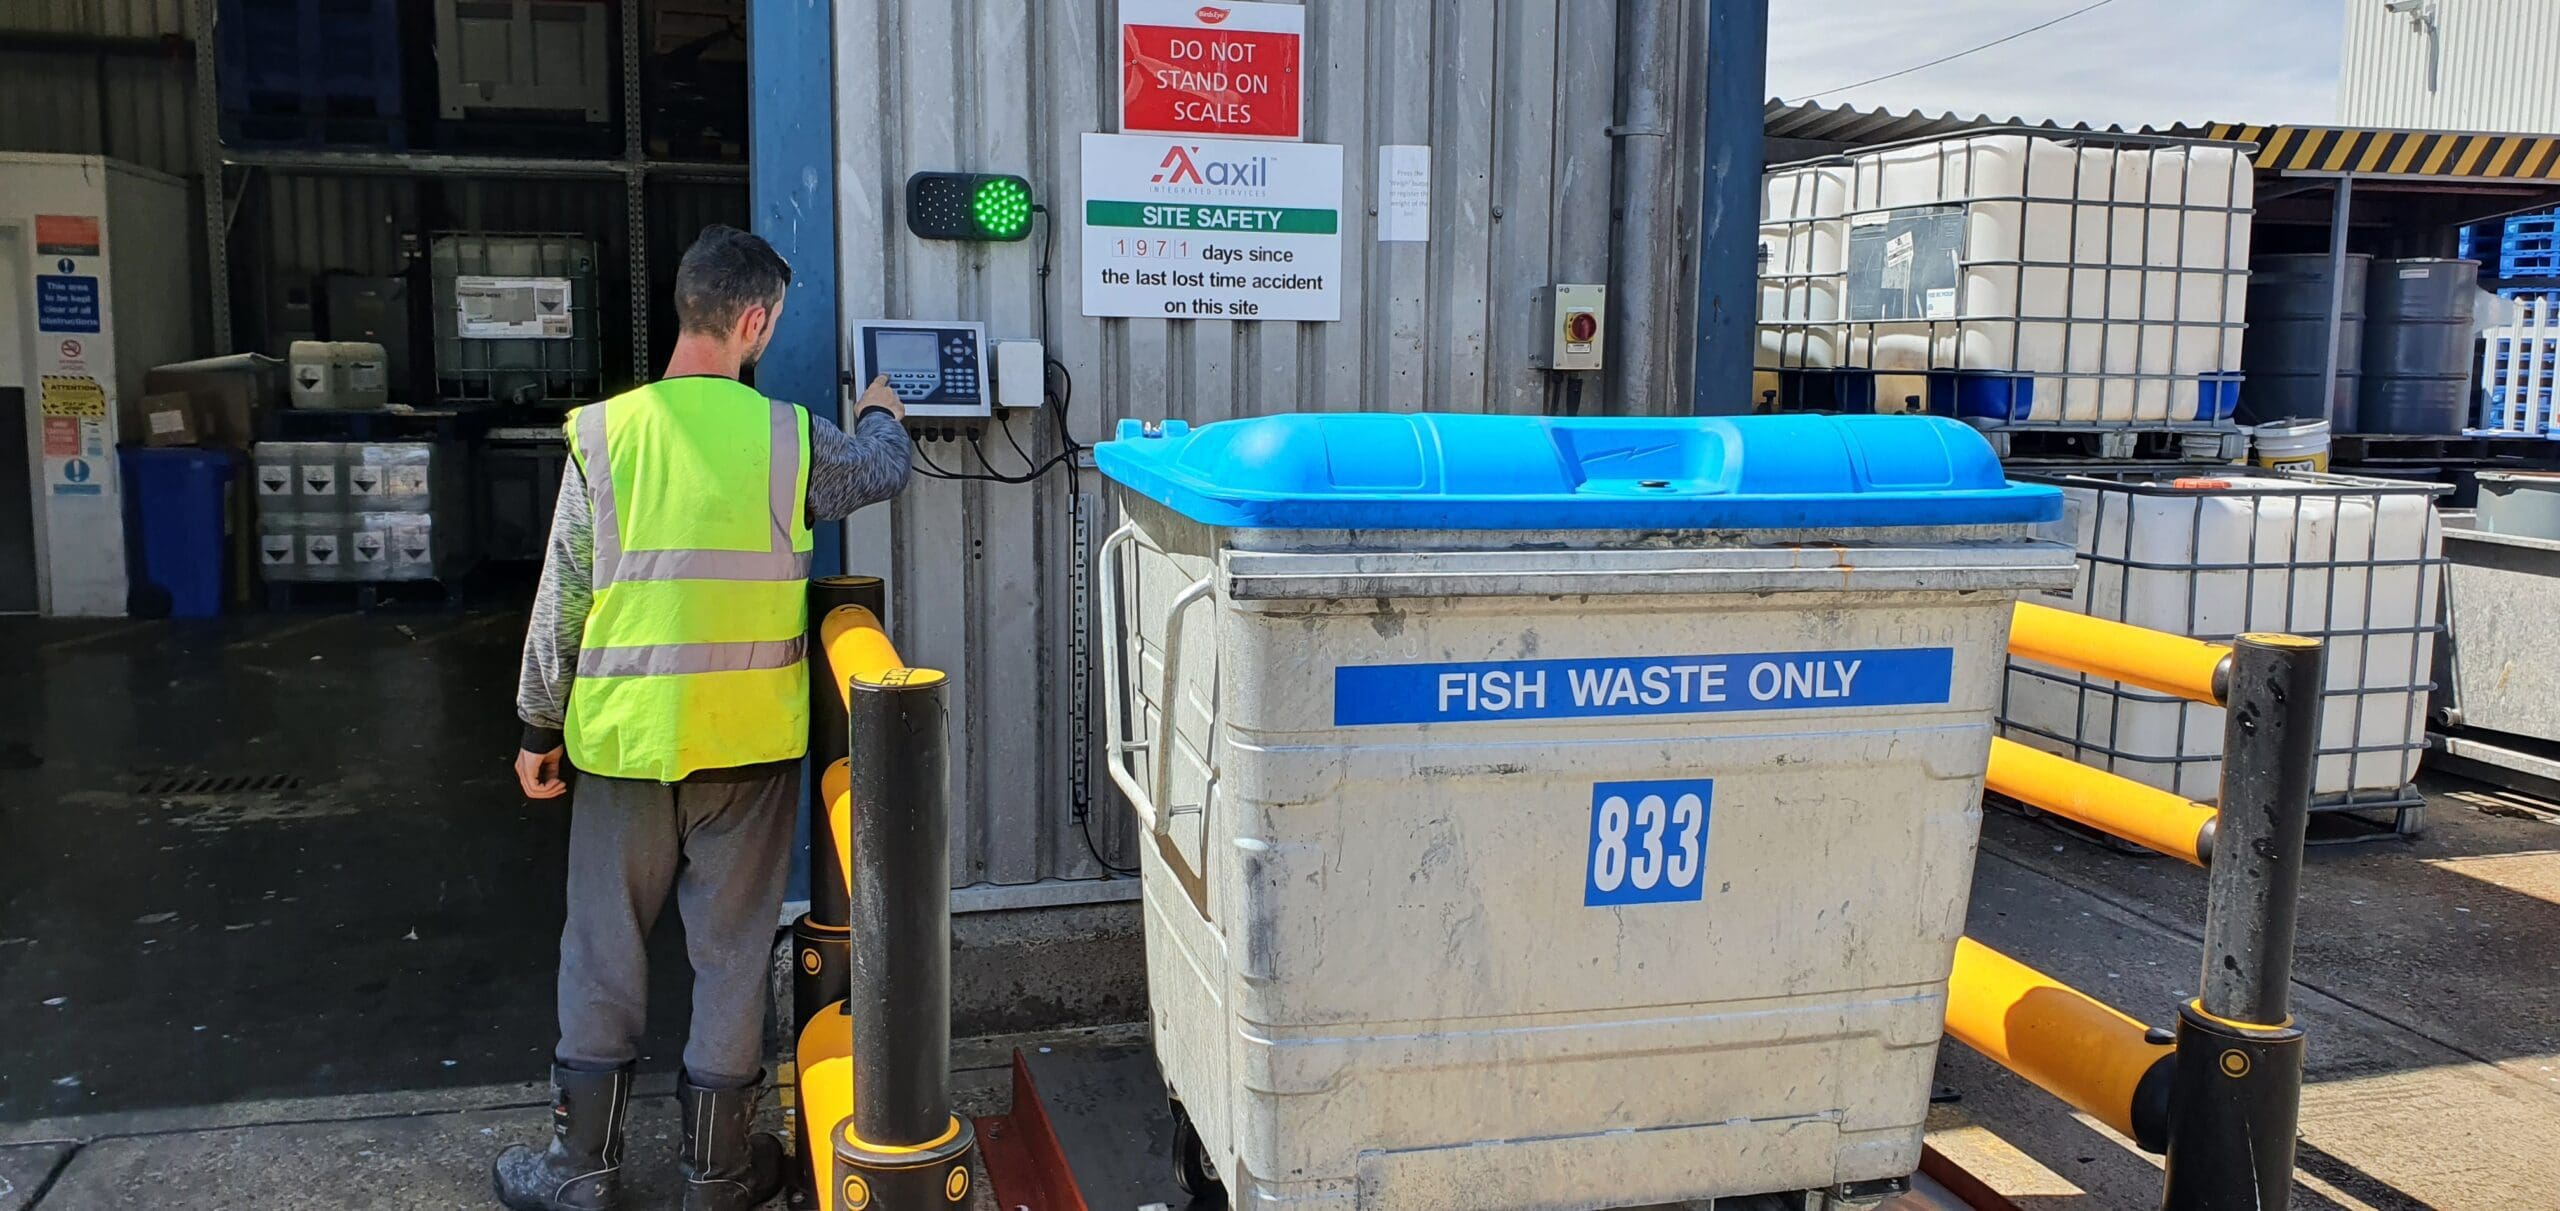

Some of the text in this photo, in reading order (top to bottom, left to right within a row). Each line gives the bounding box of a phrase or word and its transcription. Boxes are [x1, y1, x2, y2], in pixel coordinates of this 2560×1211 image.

[1170, 39, 1256, 63] DO NOT
[1156, 70, 1268, 94] STAND ON
[1174, 101, 1251, 123] SCALES
[1205, 157, 1266, 187] axil
[1149, 186, 1266, 197] INTEGRATED SERVICES
[1142, 206, 1283, 230] SITE SAFETY
[1202, 244, 1243, 265] days
[1248, 246, 1294, 262] since
[1102, 268, 1323, 290] the last lost time accident
[1164, 299, 1259, 315] on this site
[1438, 659, 1862, 712] FISH WASTE ONLY
[1594, 793, 1703, 892] 833
